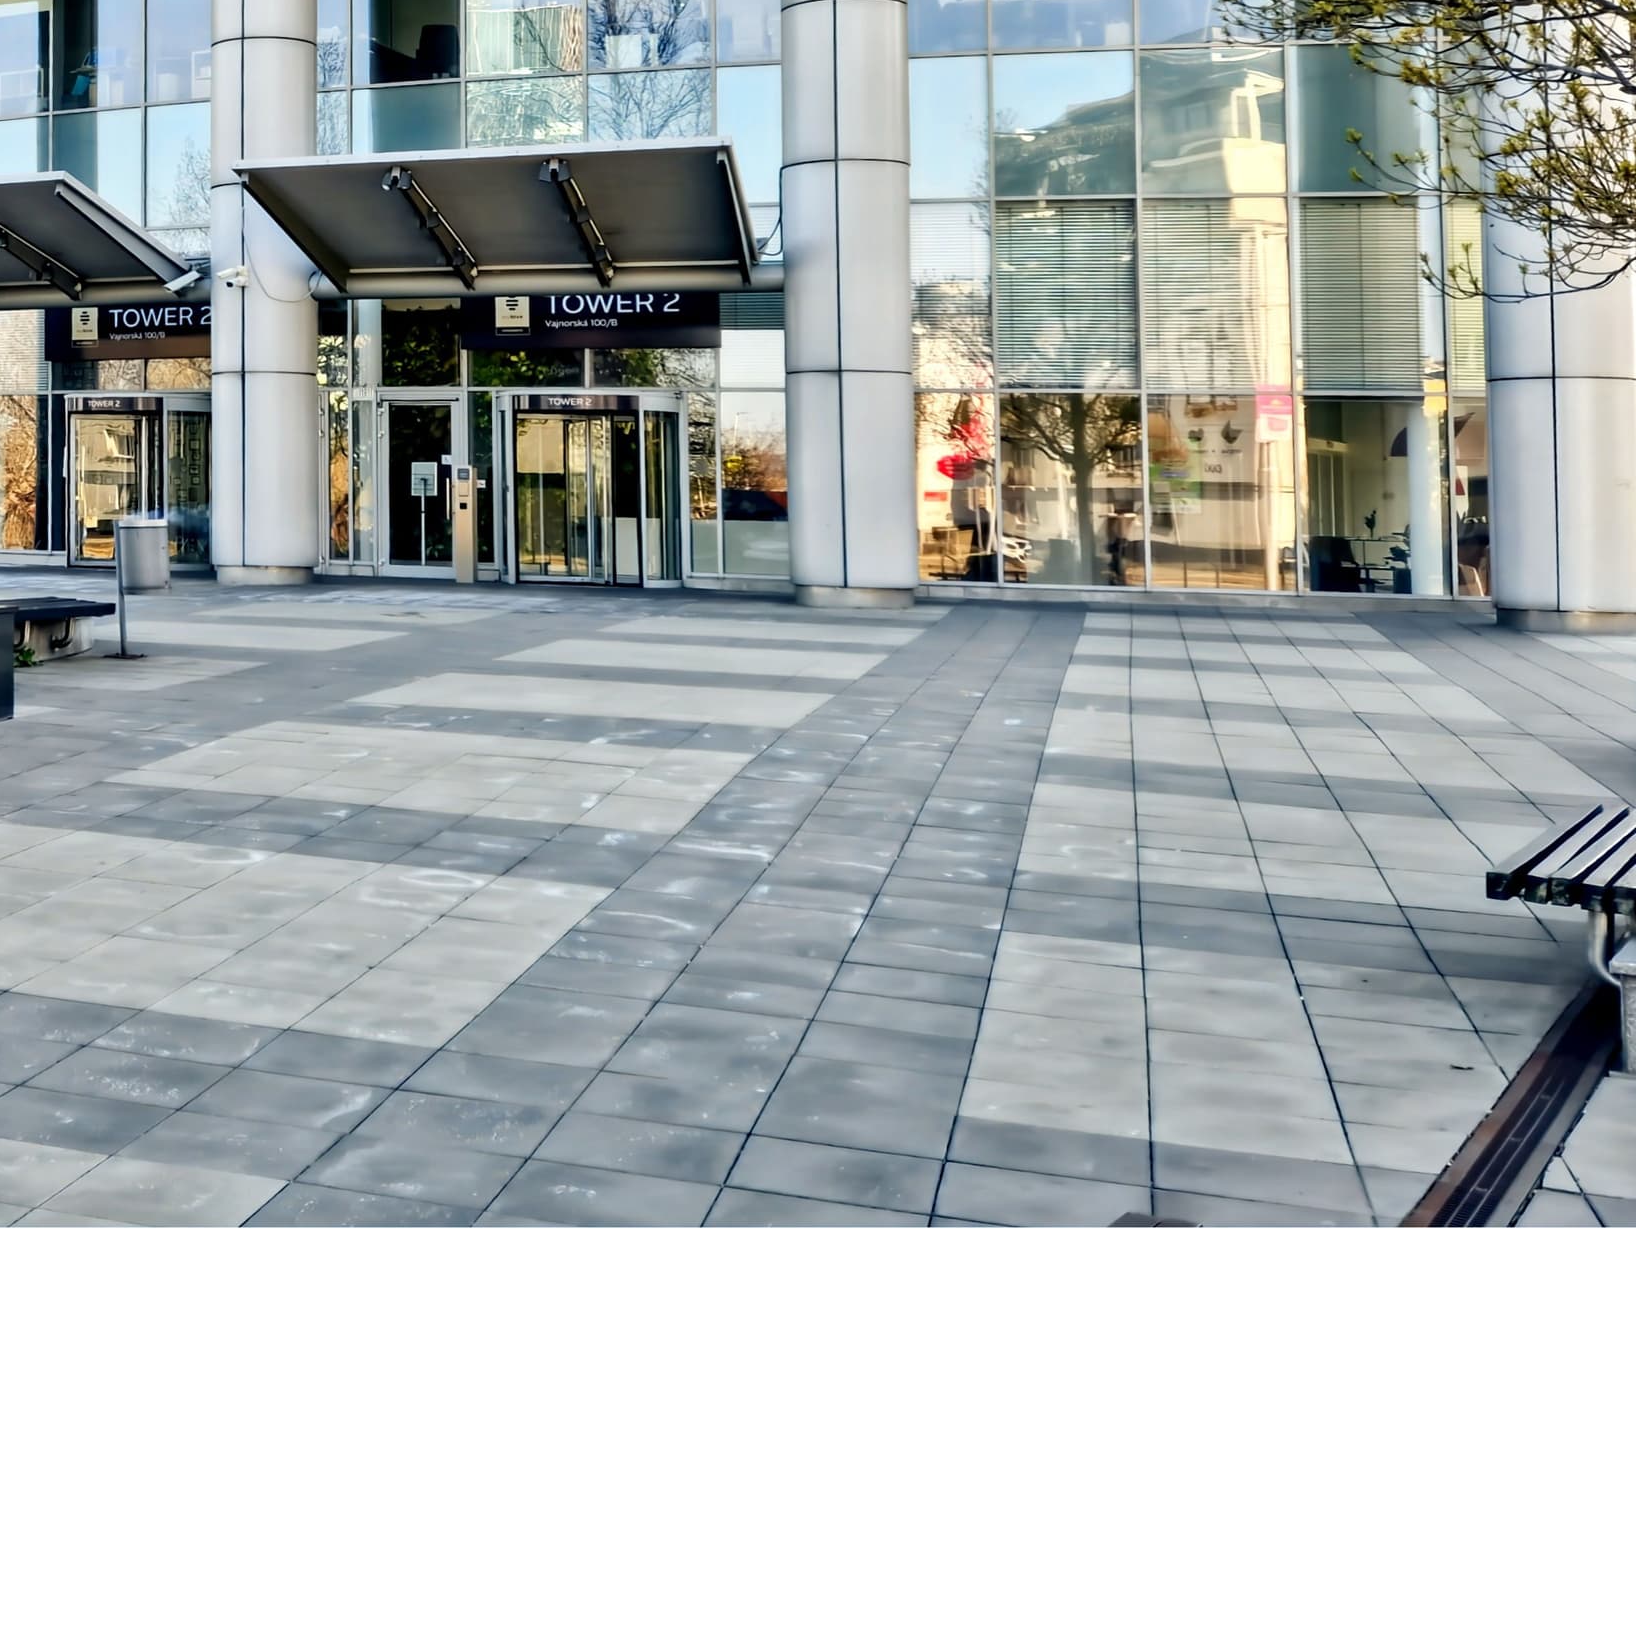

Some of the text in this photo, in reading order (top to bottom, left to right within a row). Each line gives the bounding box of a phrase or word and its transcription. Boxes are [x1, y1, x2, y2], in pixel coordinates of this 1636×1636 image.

[547, 293, 681, 315] TOWER 2
[108, 305, 212, 329] TOWER 2
[591, 318, 619, 328] 100/B
[87, 400, 114, 408] TOWER
[547, 397, 593, 407] TOWER 2
